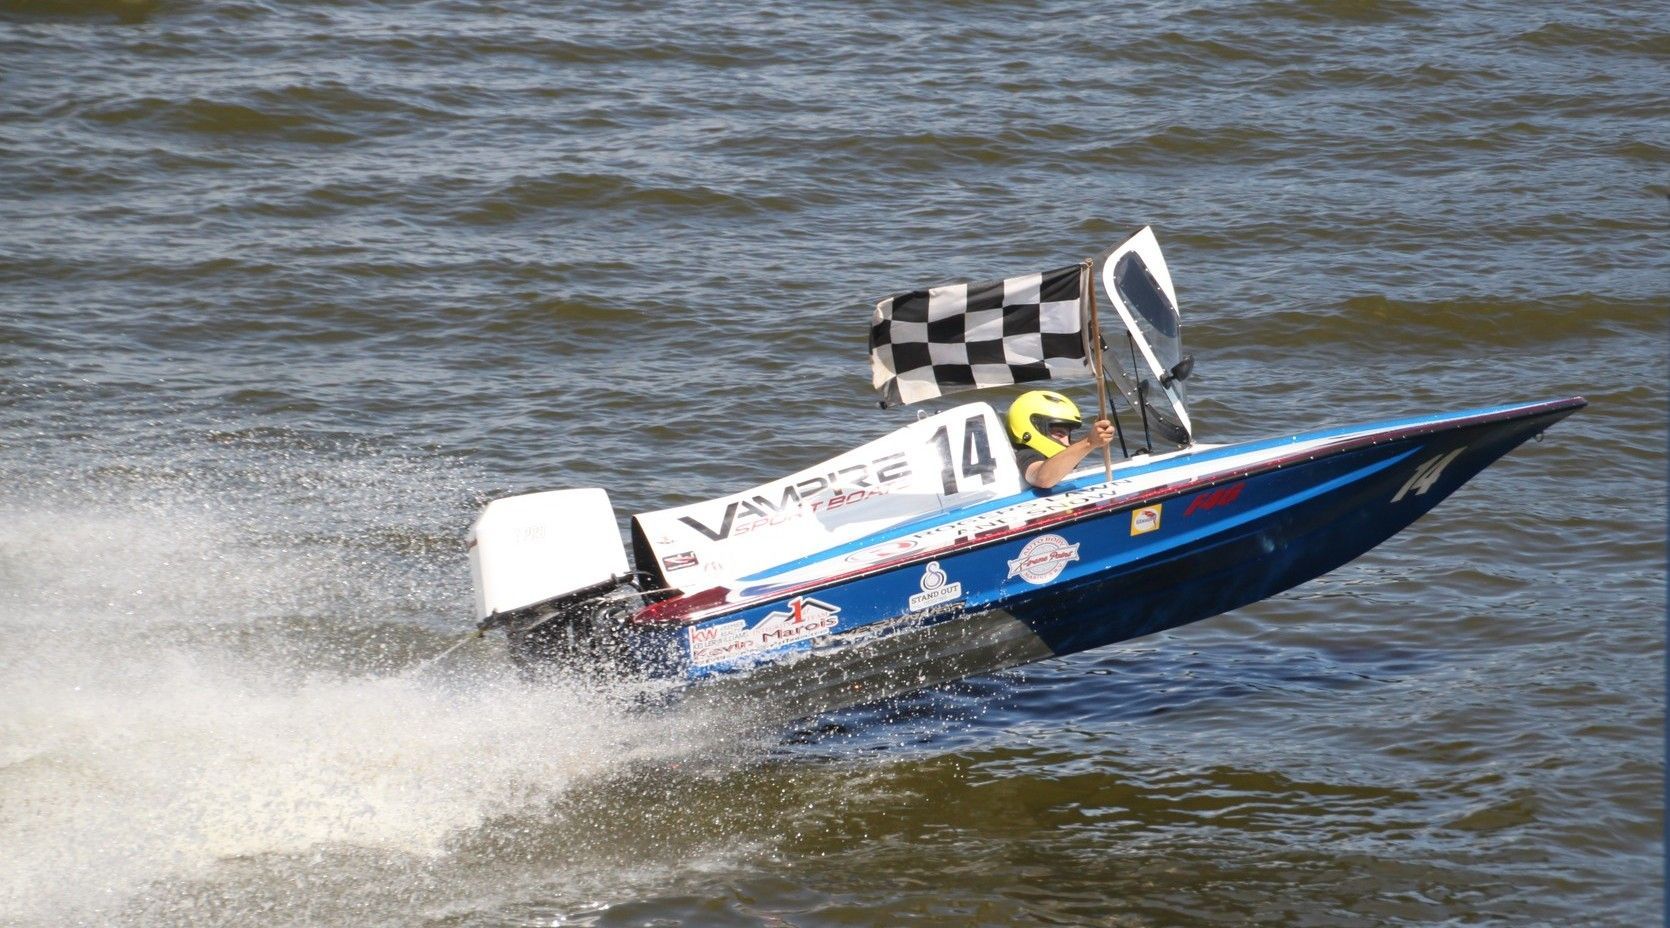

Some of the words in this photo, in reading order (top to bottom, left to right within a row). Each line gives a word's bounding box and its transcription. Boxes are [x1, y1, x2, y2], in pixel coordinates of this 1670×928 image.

[926, 414, 997, 496] 14
[1390, 446, 1468, 503] 14
[677, 452, 912, 541] VAMPIRE
[1027, 488, 1116, 515] SNOW
[1047, 478, 1132, 502] LAWN
[1023, 538, 1043, 556] AUTO
[911, 590, 939, 604] STAND
[941, 585, 959, 596] OUT
[790, 600, 805, 624] 1
[762, 617, 837, 643] Marois
